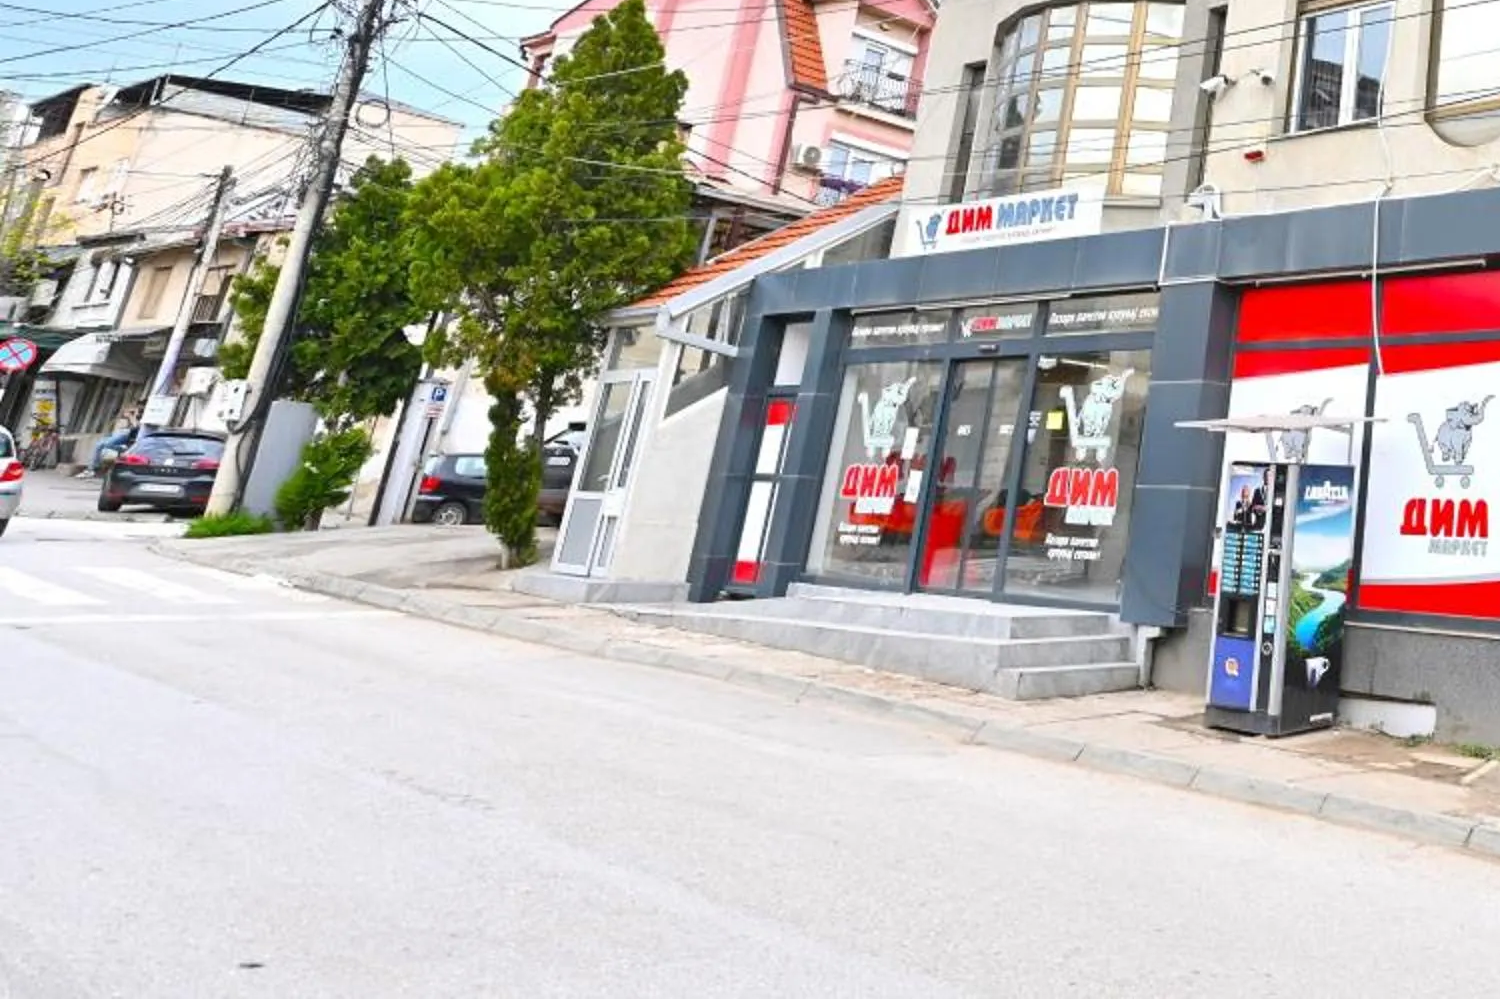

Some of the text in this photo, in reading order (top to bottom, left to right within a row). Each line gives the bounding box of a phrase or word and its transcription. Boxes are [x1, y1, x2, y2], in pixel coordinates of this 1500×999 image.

[946, 205, 993, 235] ДИМ
[996, 193, 1078, 229] МАРКЕТ
[841, 464, 898, 499] ДИМ
[1044, 467, 1118, 507] ДИМ
[1400, 498, 1488, 537] ДИМ
[1427, 538, 1488, 557] МАРКЕТ
